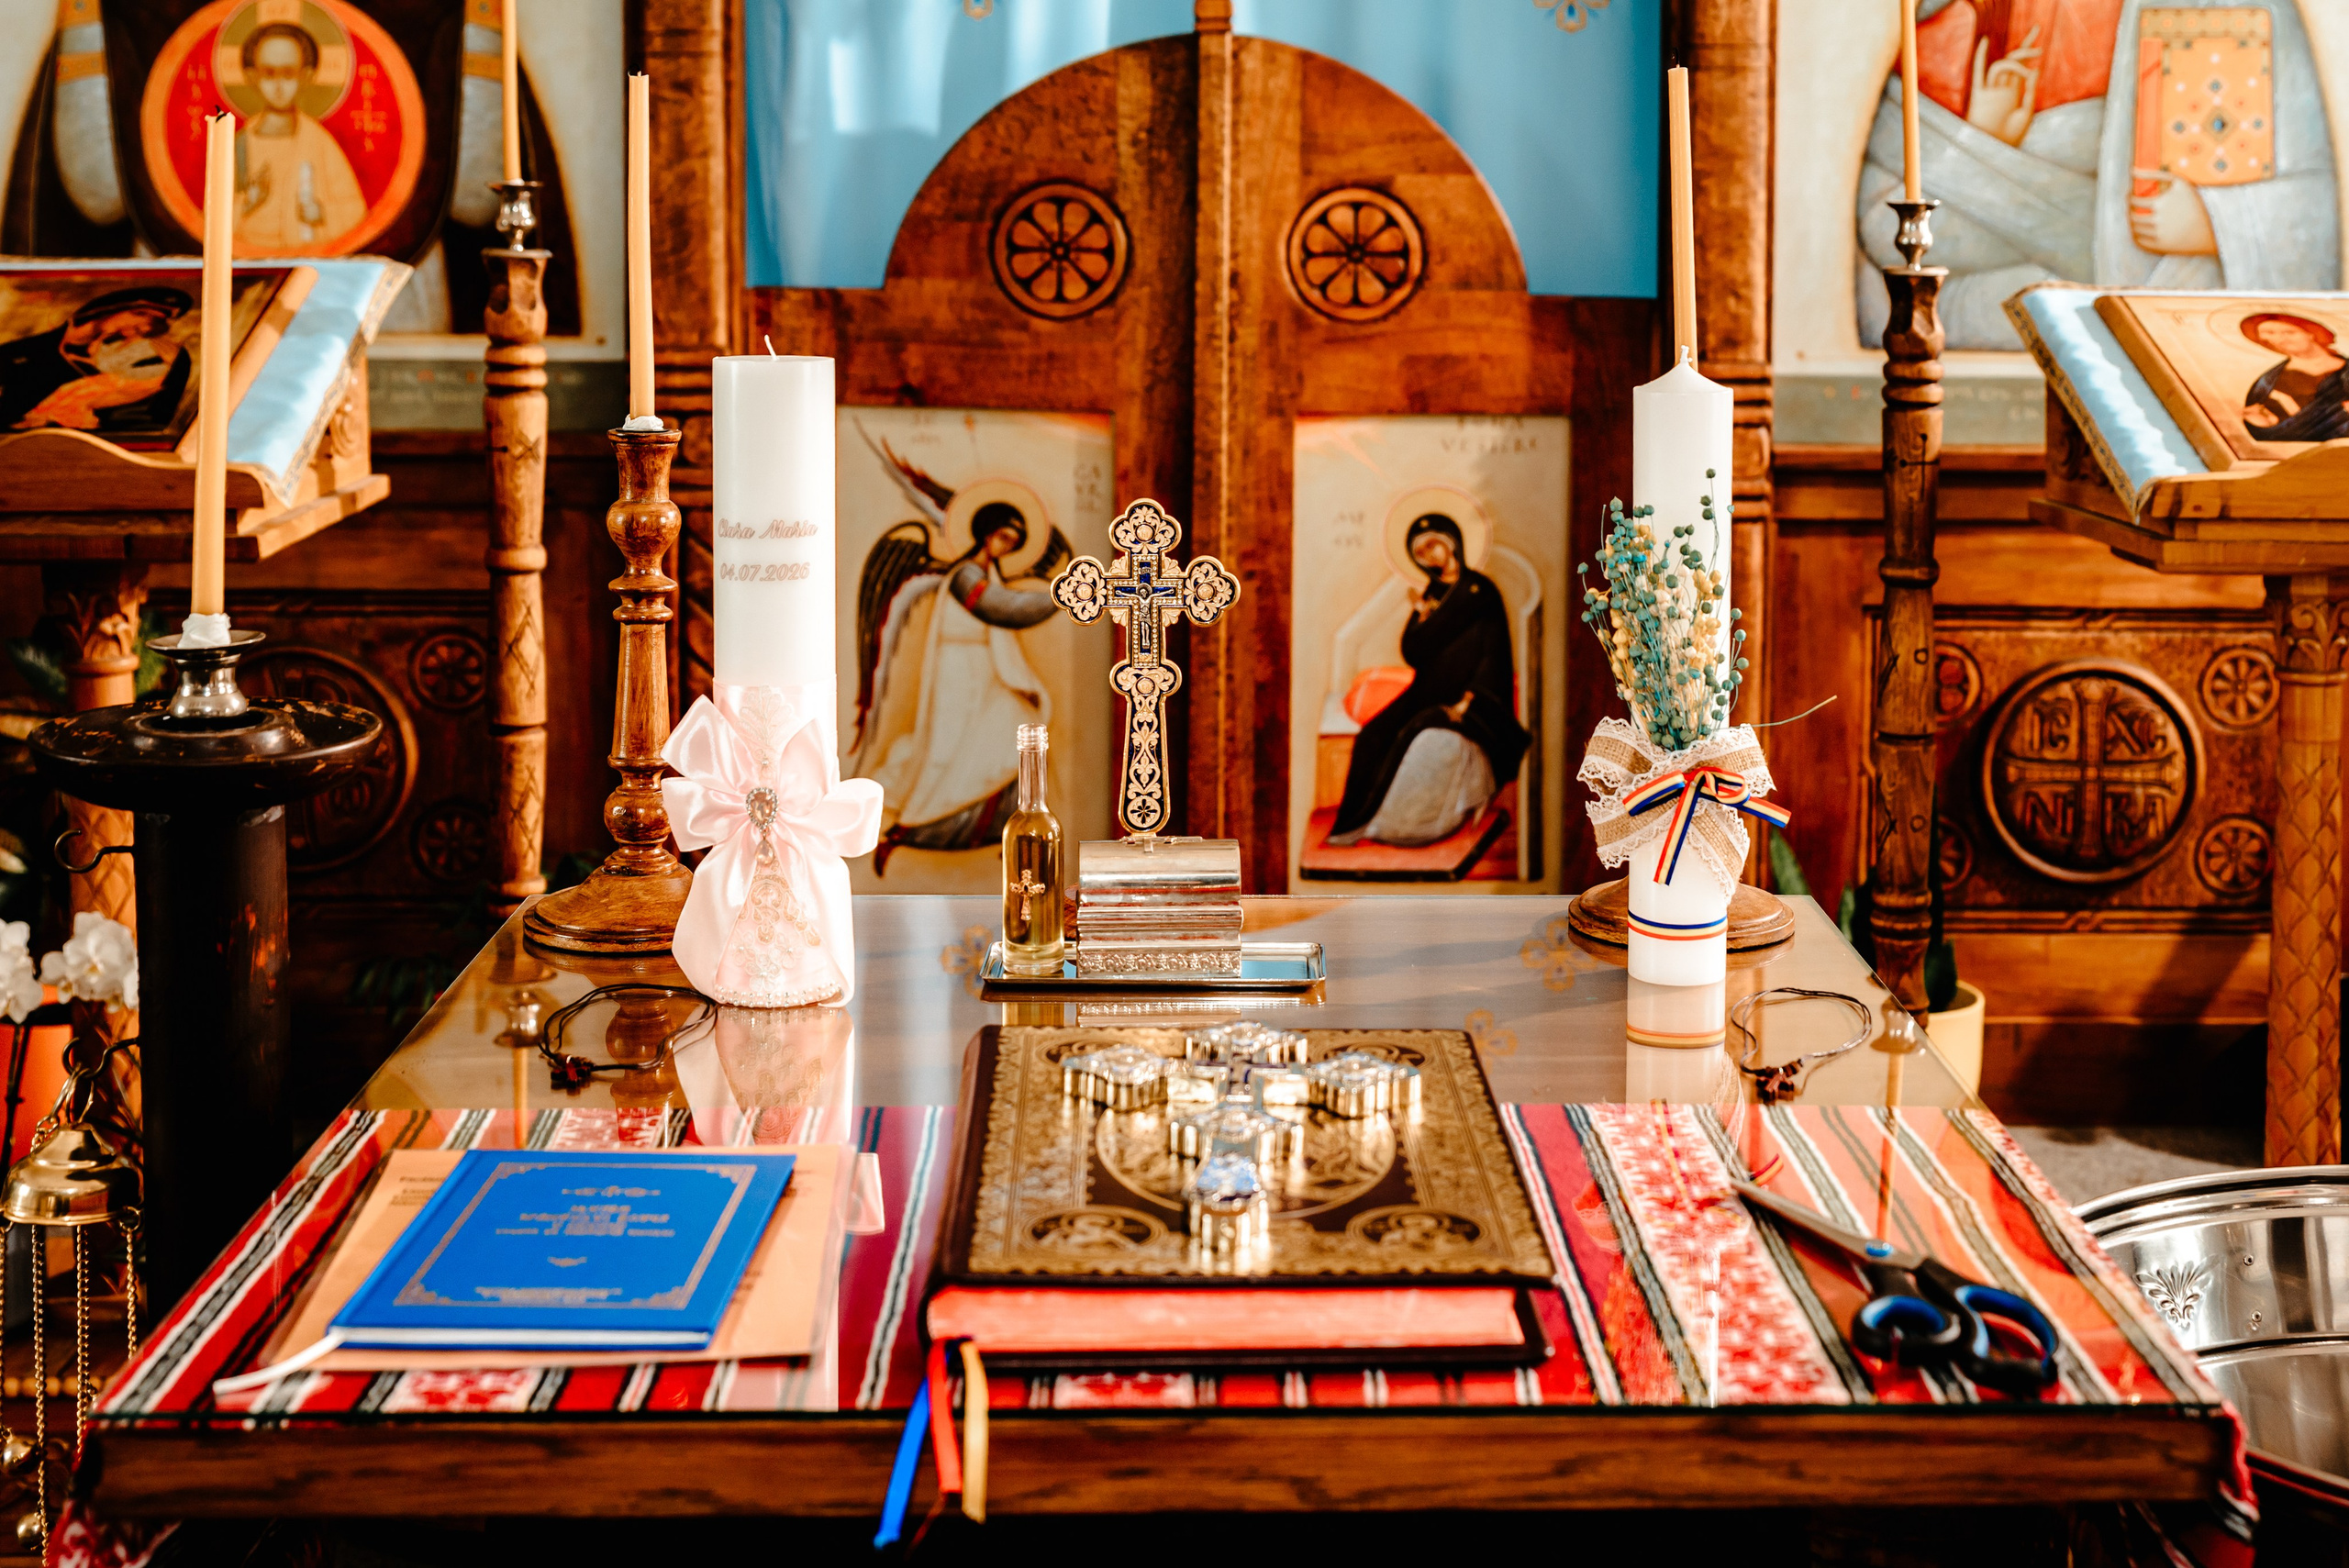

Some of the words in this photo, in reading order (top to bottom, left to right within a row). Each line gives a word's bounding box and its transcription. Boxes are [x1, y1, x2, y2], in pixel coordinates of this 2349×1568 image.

[718, 518, 754, 539] Clara
[759, 519, 818, 539] Maria
[719, 562, 810, 582] 04.07.2026
